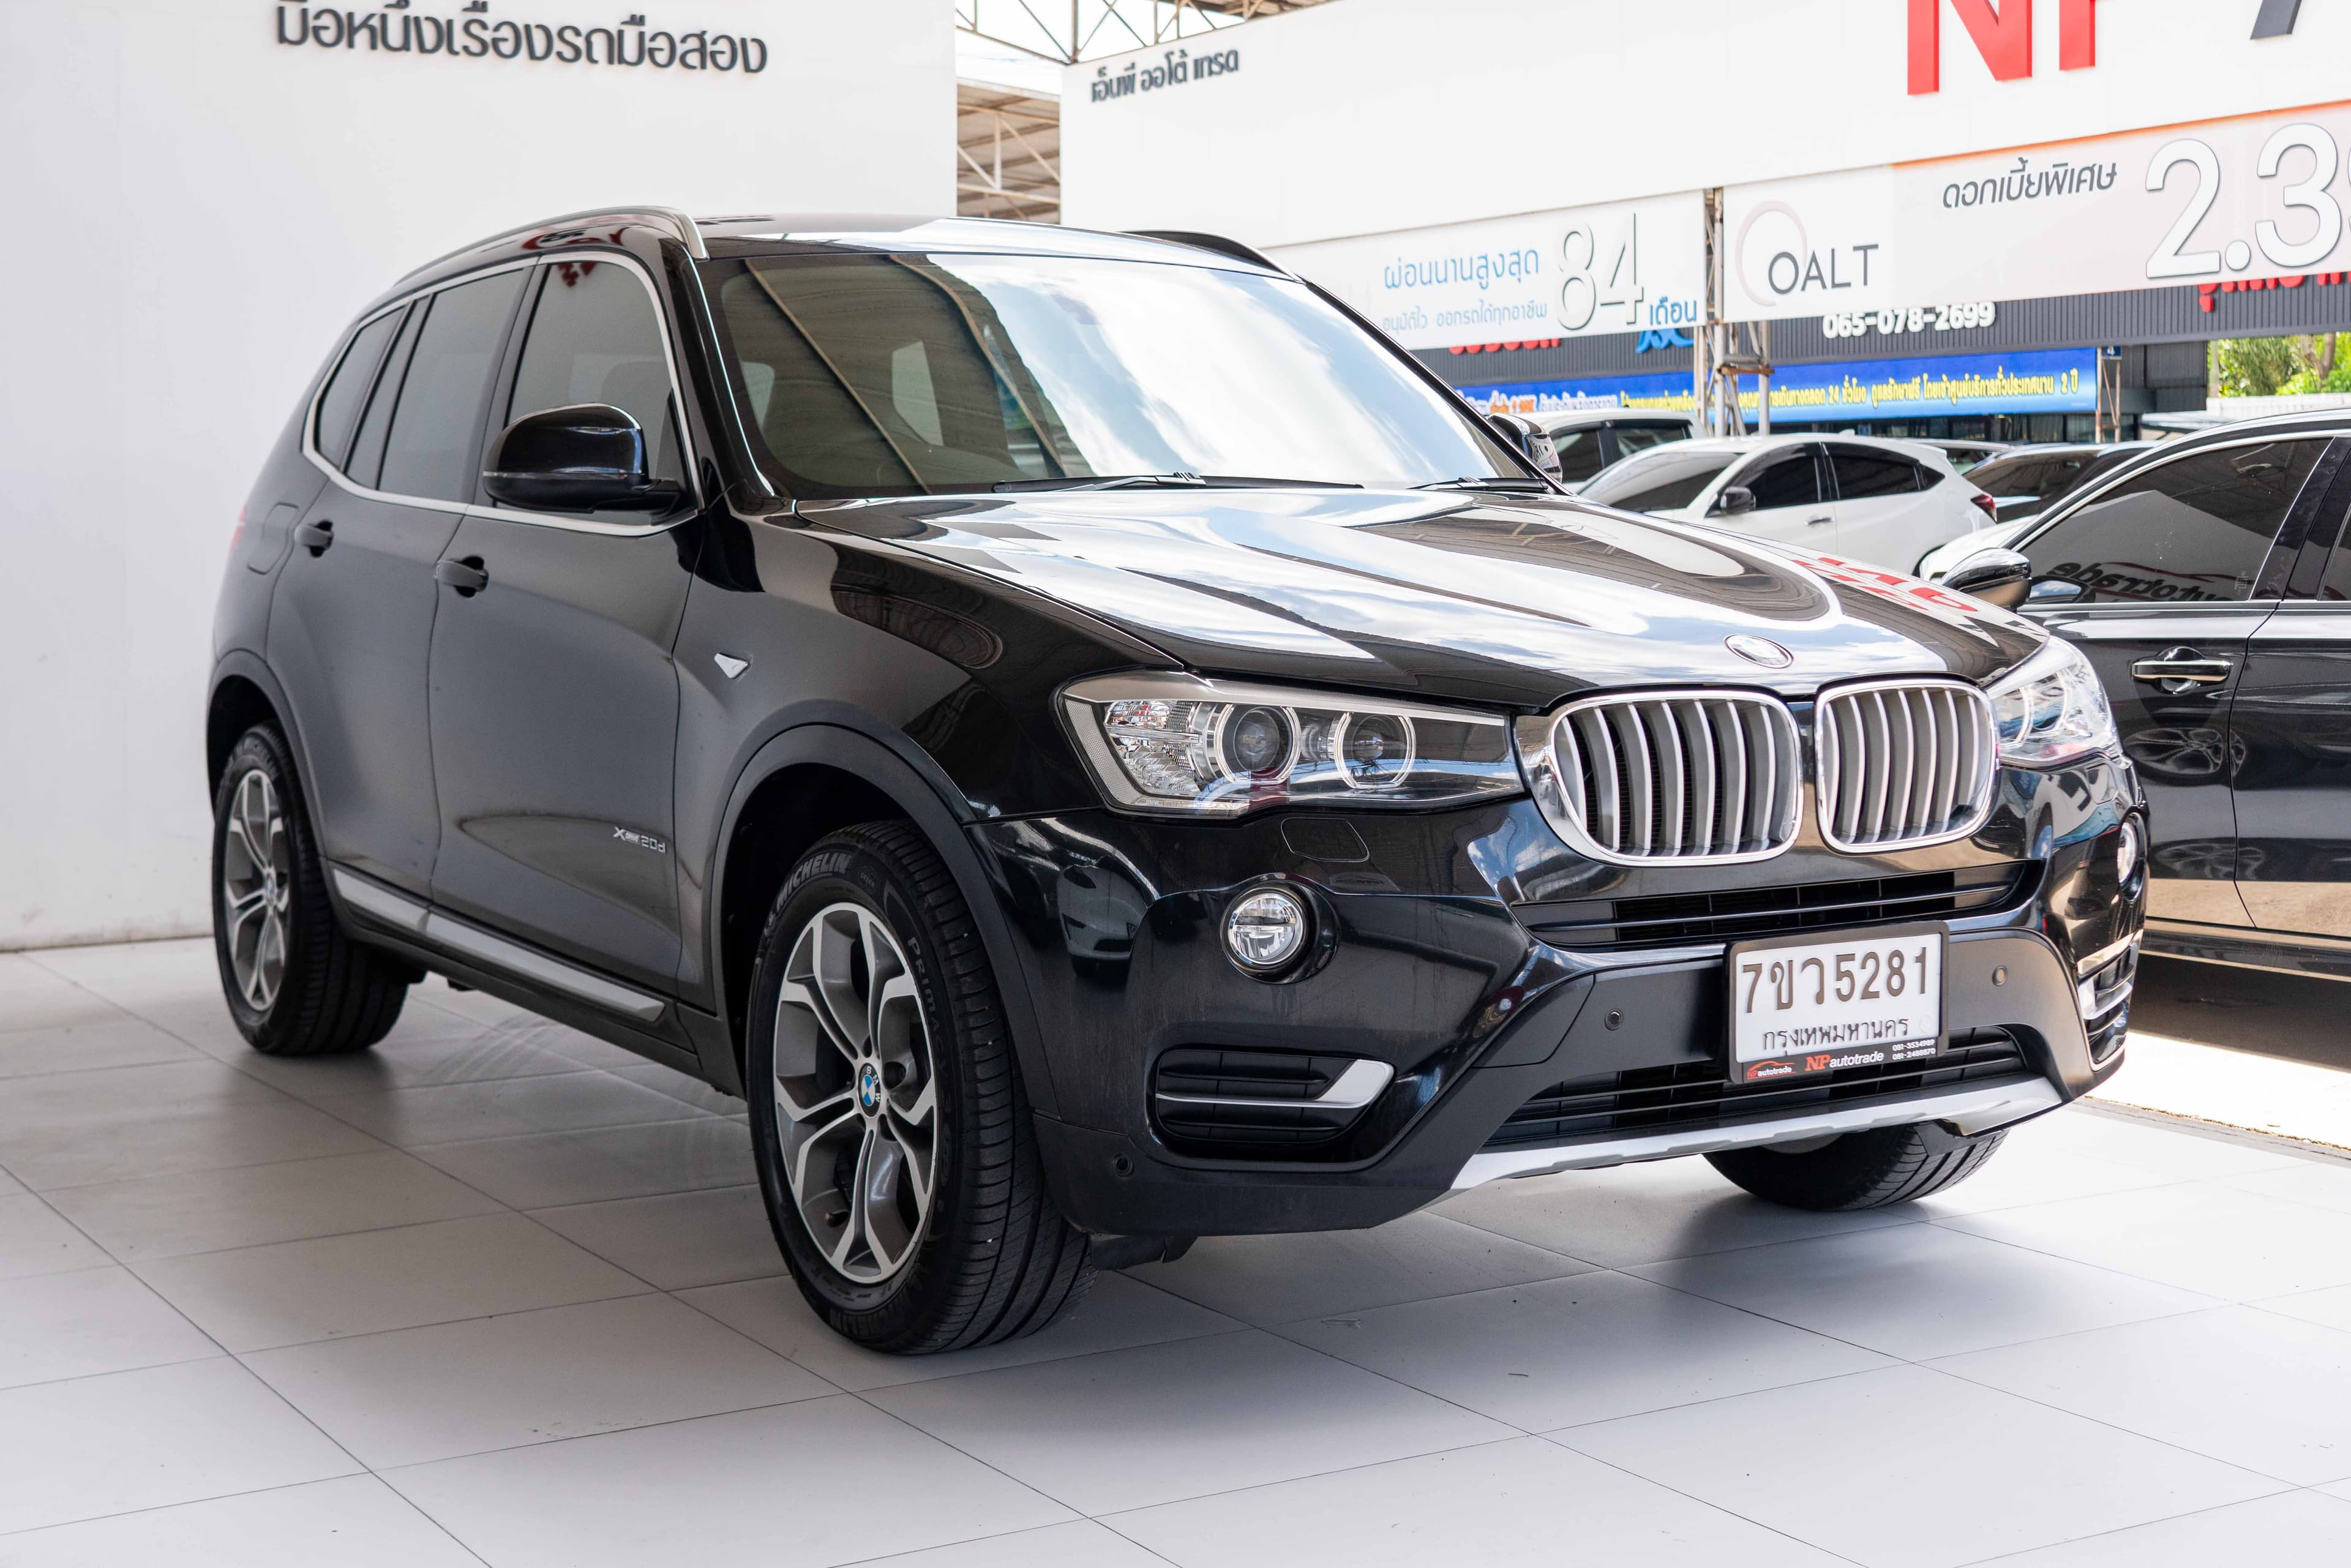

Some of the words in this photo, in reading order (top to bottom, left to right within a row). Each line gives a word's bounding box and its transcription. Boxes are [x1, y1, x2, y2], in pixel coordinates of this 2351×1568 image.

[1943, 157, 2117, 208] ดอกเบี้ยพิเศษ
[2145, 122, 2351, 280] 2.3
[1384, 249, 1539, 290] ผ่อนนานสูงสุด
[1557, 212, 1644, 331] 84
[1649, 296, 1697, 325] เดือน
[1822, 301, 1996, 339] 065-078-2699
[1835, 947, 1927, 1002] 5281
[1763, 1018, 1908, 1057] กรุงเทพมหานคร
